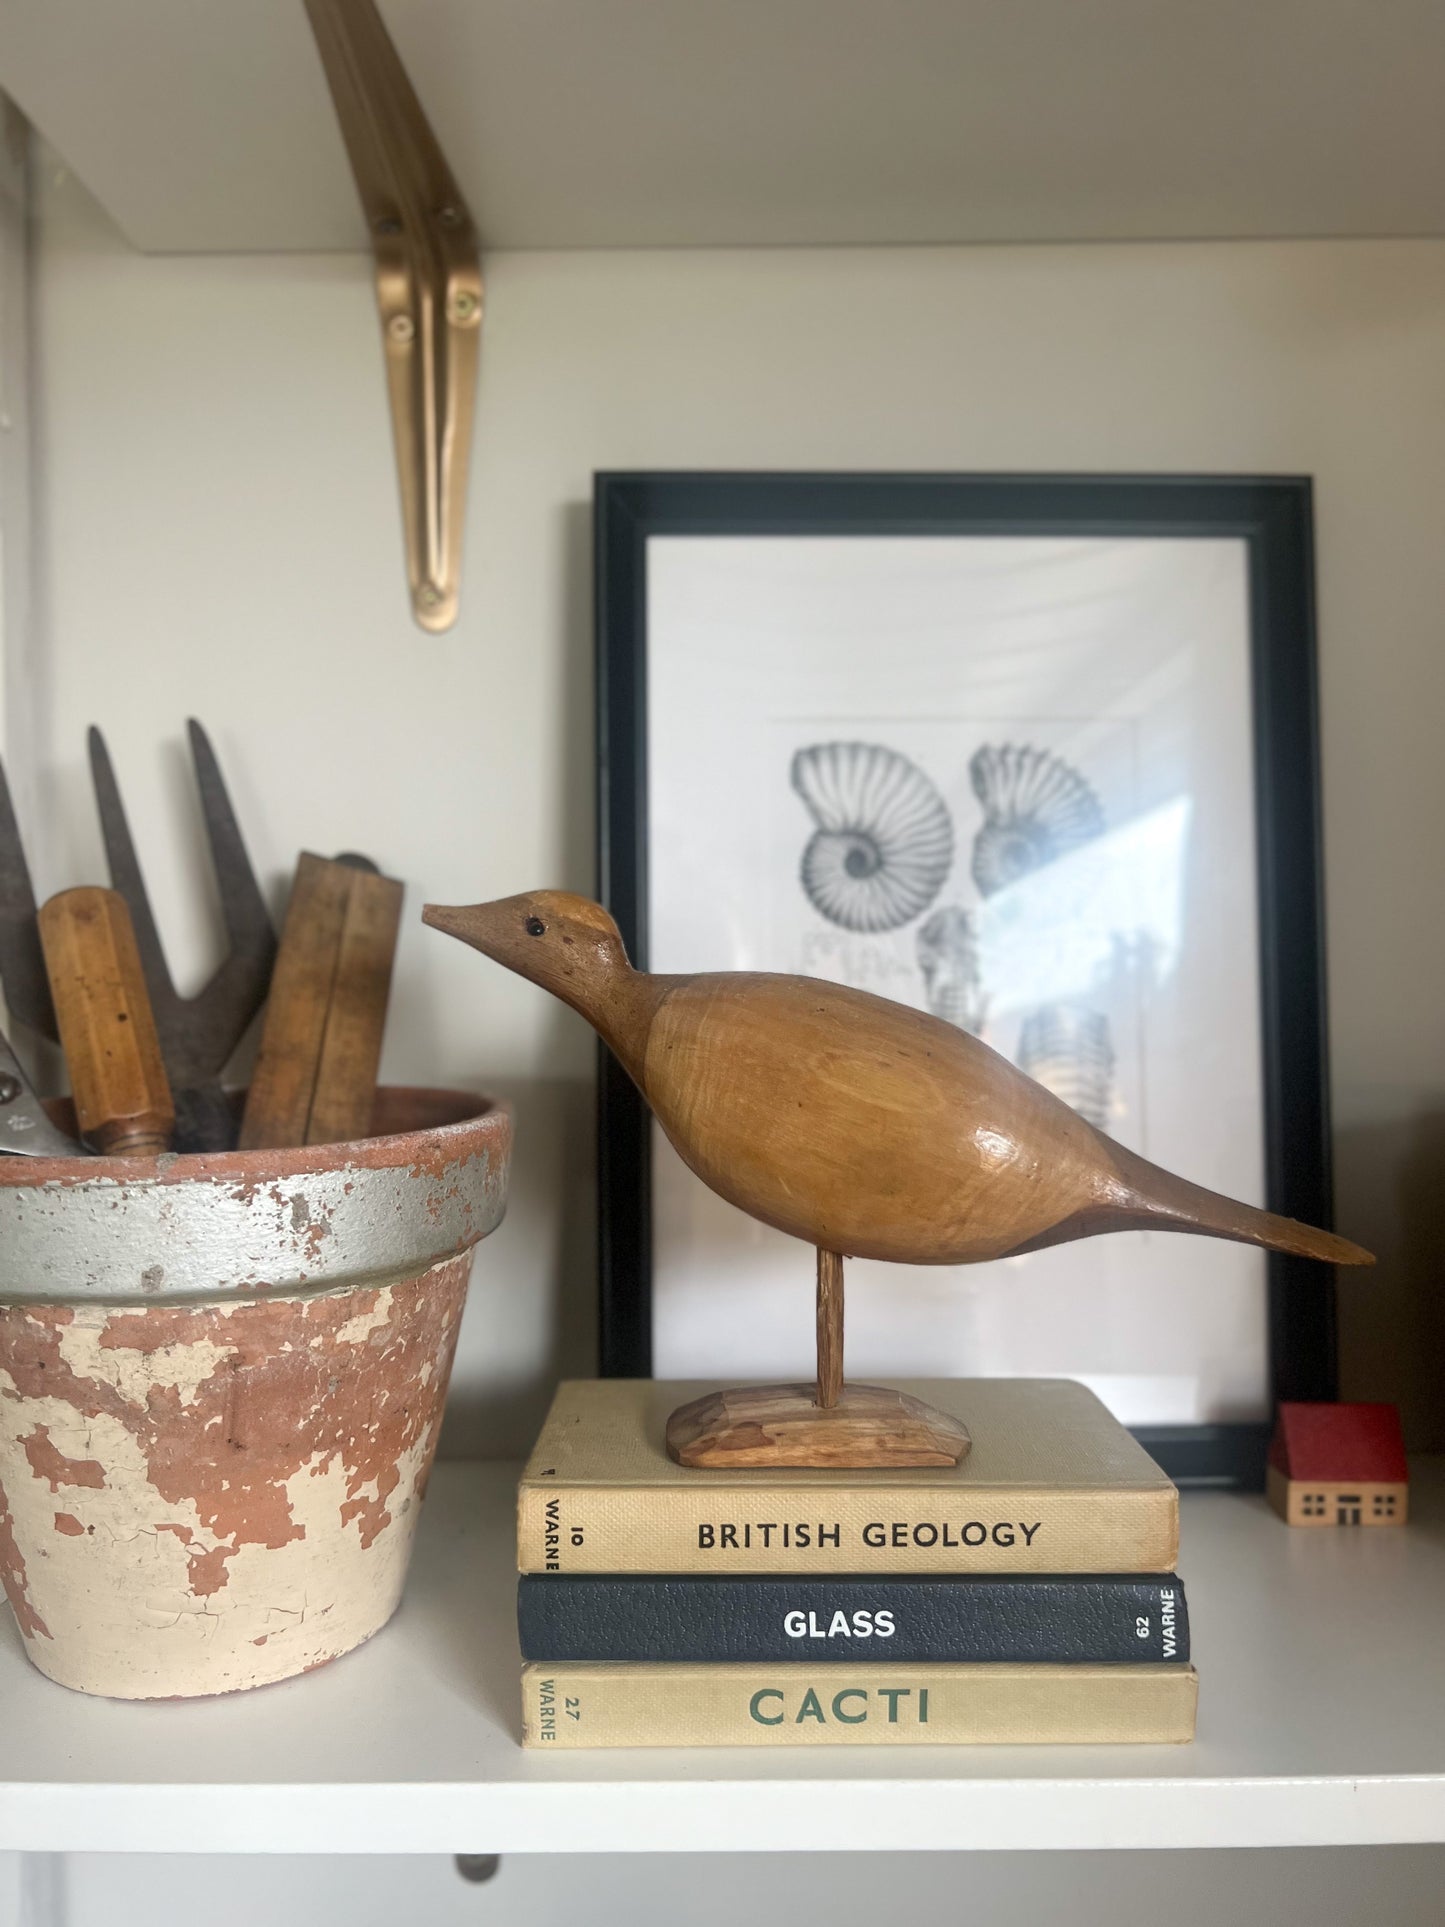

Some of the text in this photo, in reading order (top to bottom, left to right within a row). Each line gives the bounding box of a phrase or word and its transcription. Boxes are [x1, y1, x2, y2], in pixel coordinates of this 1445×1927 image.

[545, 1499, 560, 1570] WARNE
[698, 1522, 1042, 1548] BRITISH GEOLOGY
[783, 1610, 896, 1638] GLASS
[1135, 1616, 1150, 1638] 62
[1160, 1589, 1177, 1657] WARNE
[539, 1679, 556, 1740] WARNE
[565, 1697, 580, 1721] 27
[749, 1688, 929, 1725] CACTI
